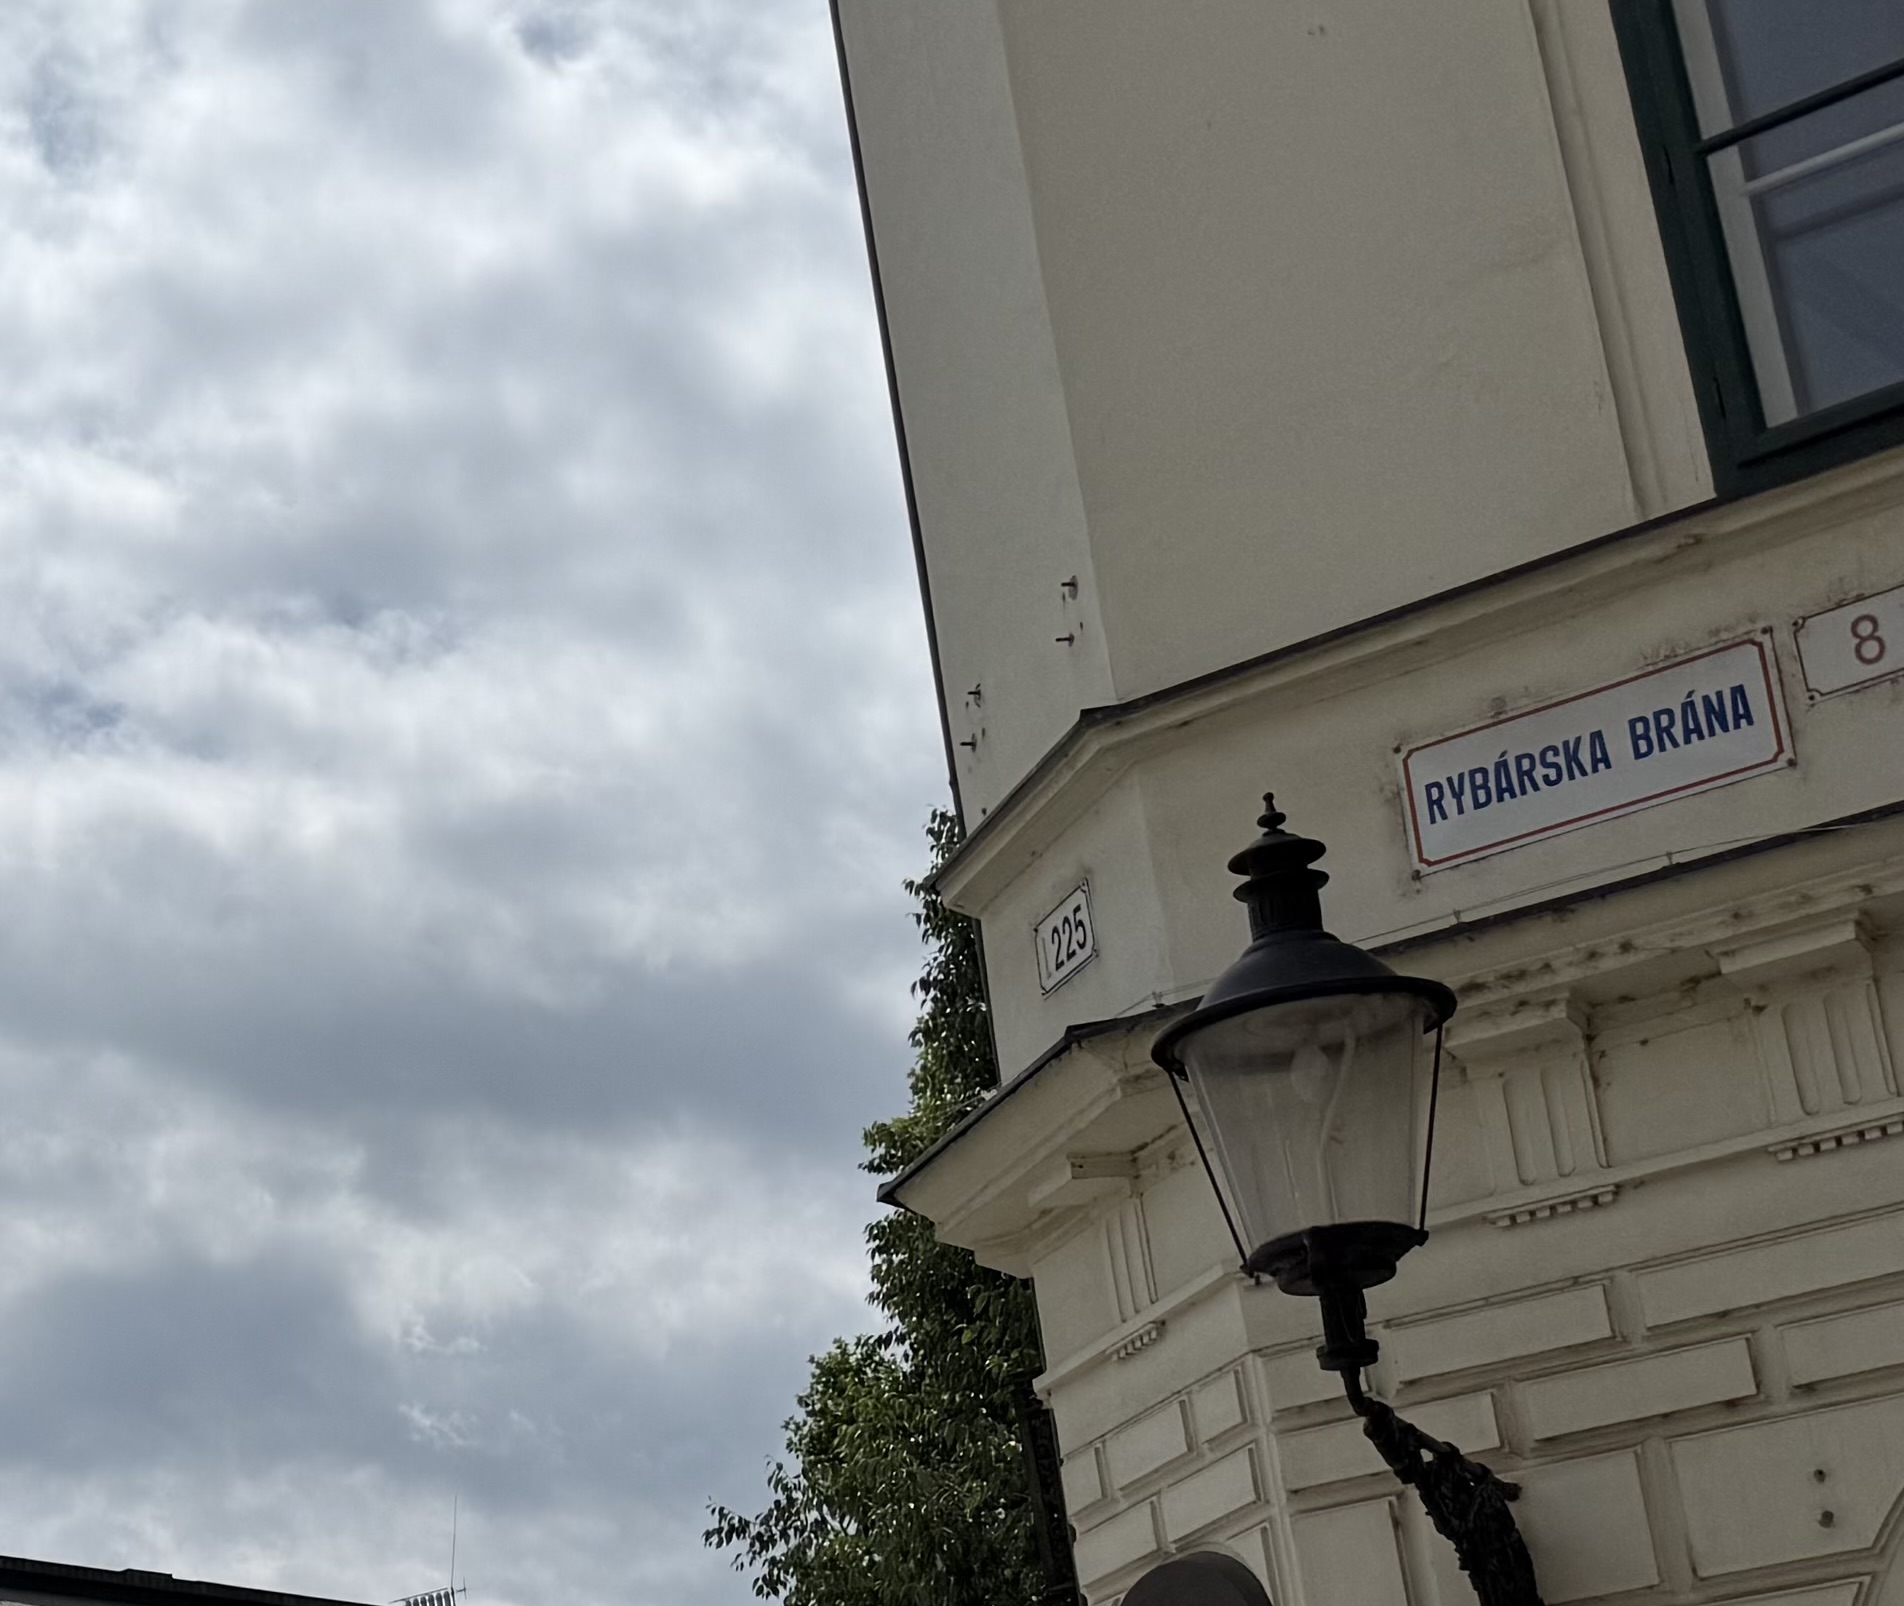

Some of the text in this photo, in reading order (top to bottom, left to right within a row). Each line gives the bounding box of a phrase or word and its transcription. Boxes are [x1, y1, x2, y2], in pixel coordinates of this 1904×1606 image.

[1850, 614, 1886, 666] 8
[1425, 684, 1755, 825] RYBÁRSKA BRÁNA
[1052, 904, 1087, 971] 225
